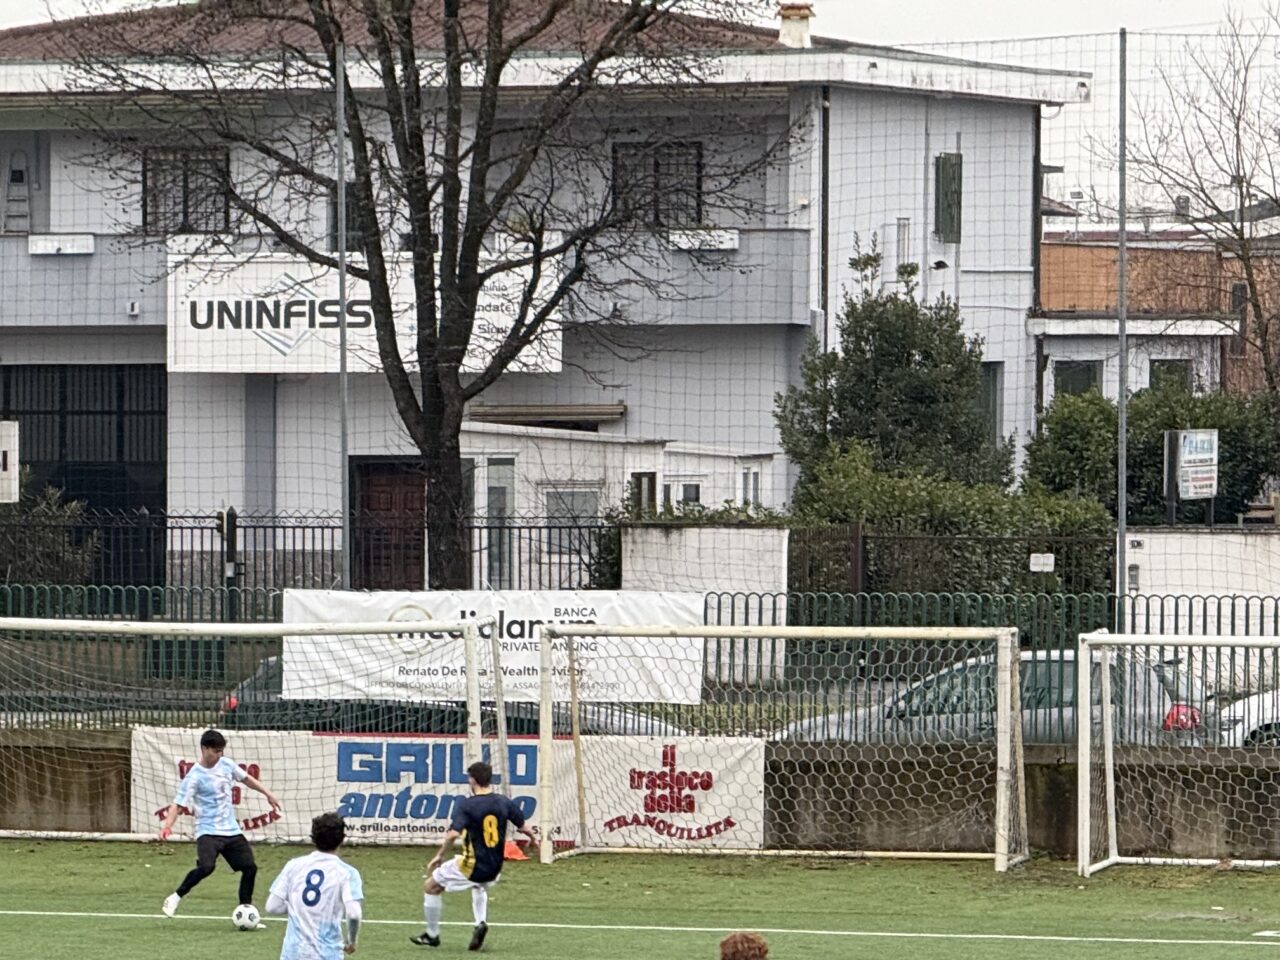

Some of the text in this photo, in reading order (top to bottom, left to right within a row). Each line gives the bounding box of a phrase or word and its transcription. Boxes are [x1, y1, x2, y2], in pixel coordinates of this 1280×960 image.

[189, 299, 374, 330] UNINFISS
[554, 607, 597, 617] BANCA
[552, 642, 598, 652] ANING
[398, 666, 439, 677] Renato
[441, 666, 458, 676] De
[629, 767, 713, 791] trasloco
[337, 786, 538, 820] antono
[644, 788, 696, 813] della
[483, 814, 499, 848] 8
[302, 869, 325, 907] 8
